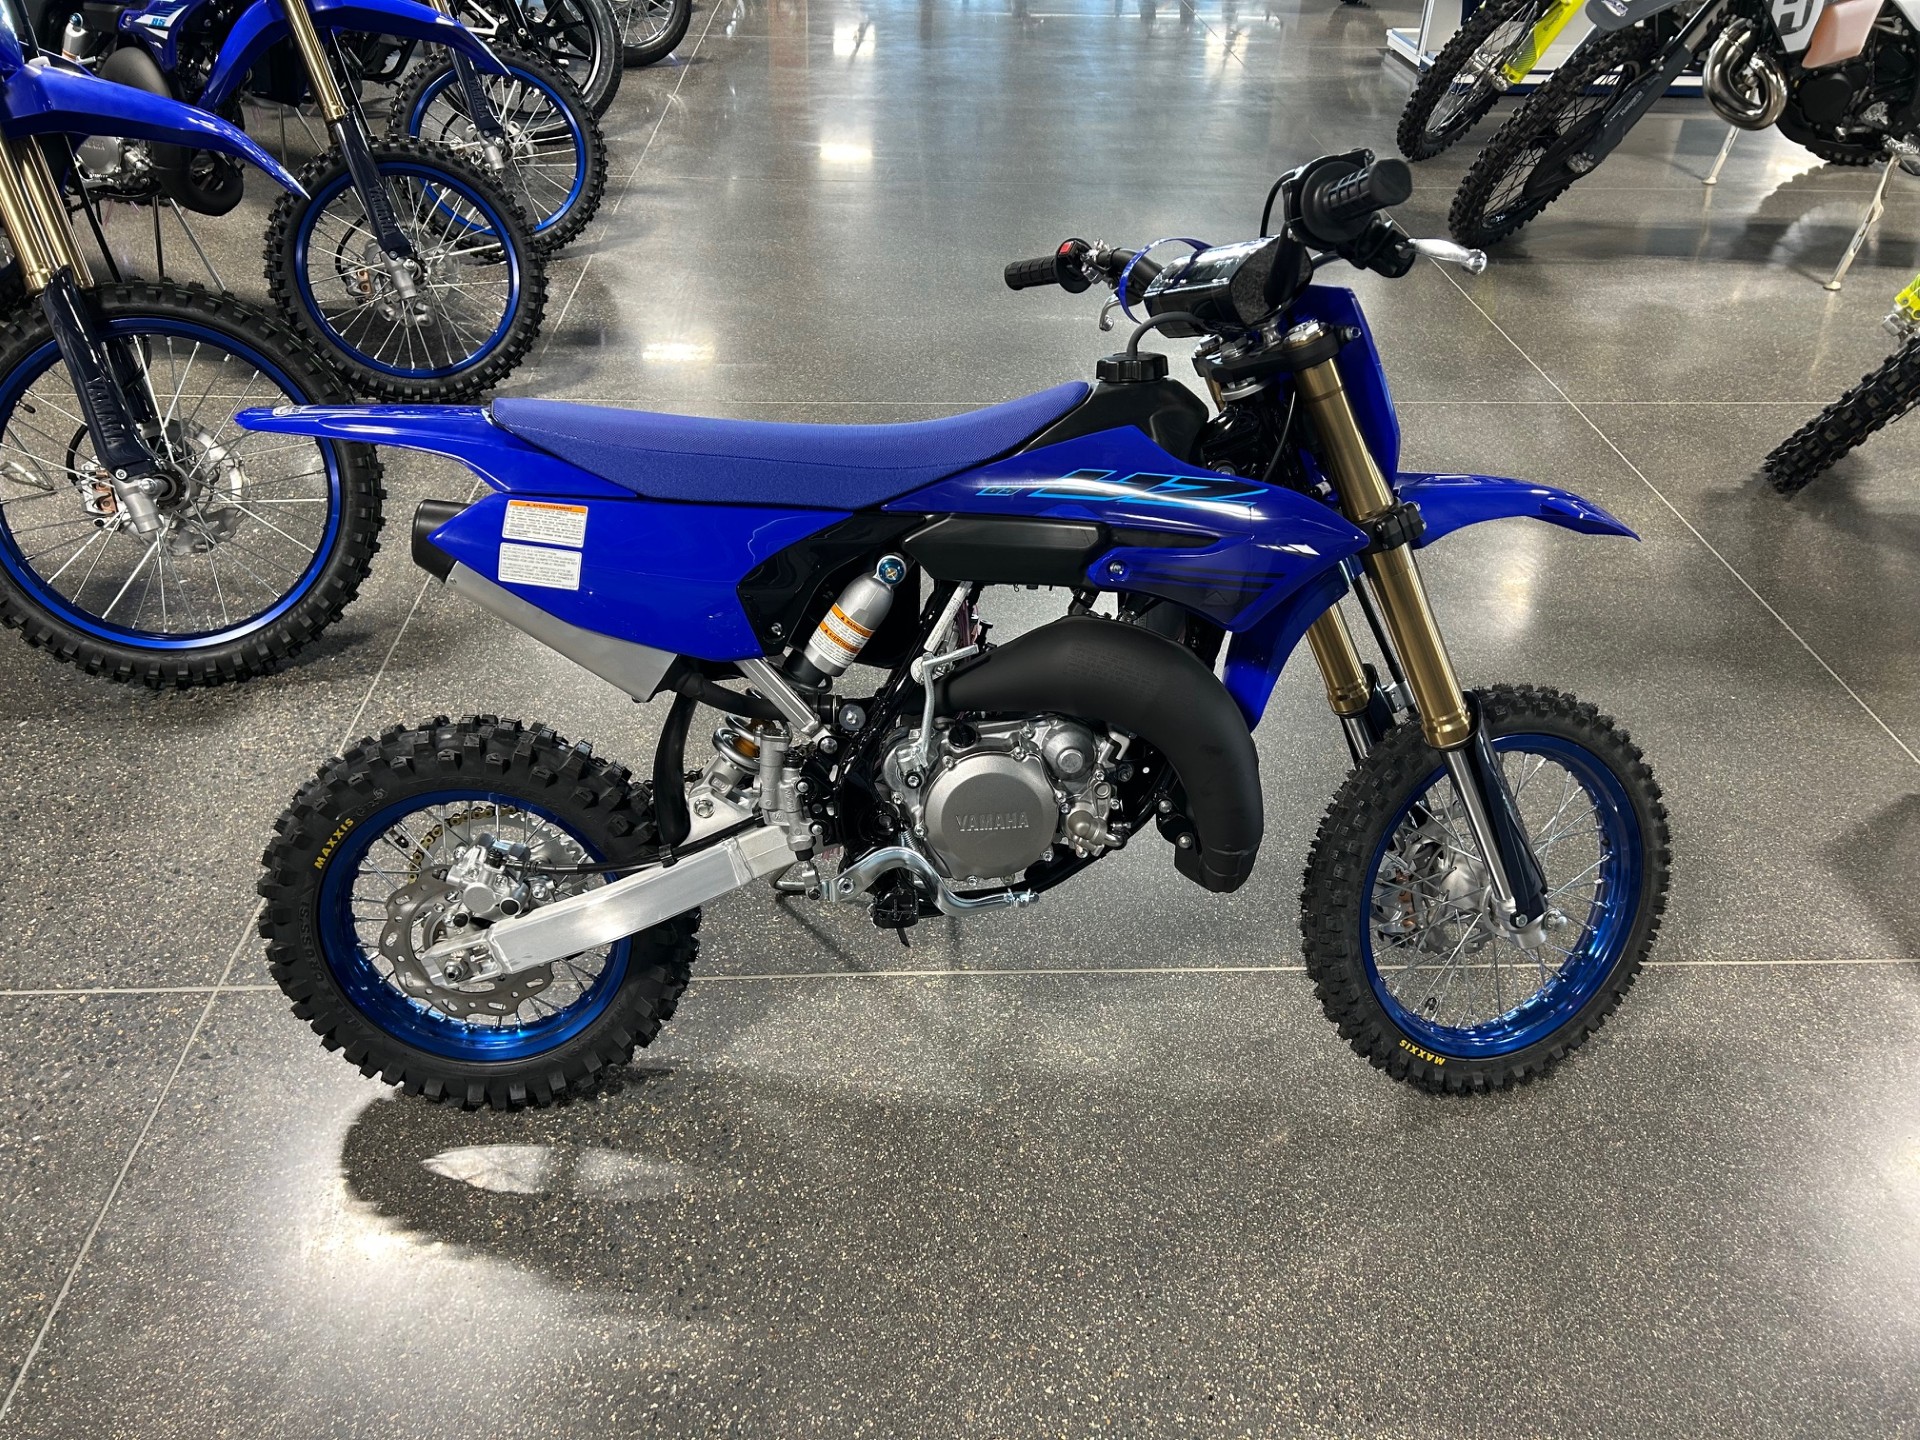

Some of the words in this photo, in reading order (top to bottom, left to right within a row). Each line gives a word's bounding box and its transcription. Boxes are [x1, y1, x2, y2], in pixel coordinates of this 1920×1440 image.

[368, 185, 397, 240] YAMAHA
[85, 376, 125, 449] YAMAHA
[313, 817, 354, 870] MAXXIS
[955, 811, 1030, 832] YAMAHA
[1399, 1039, 1446, 1066] MAXXIS
